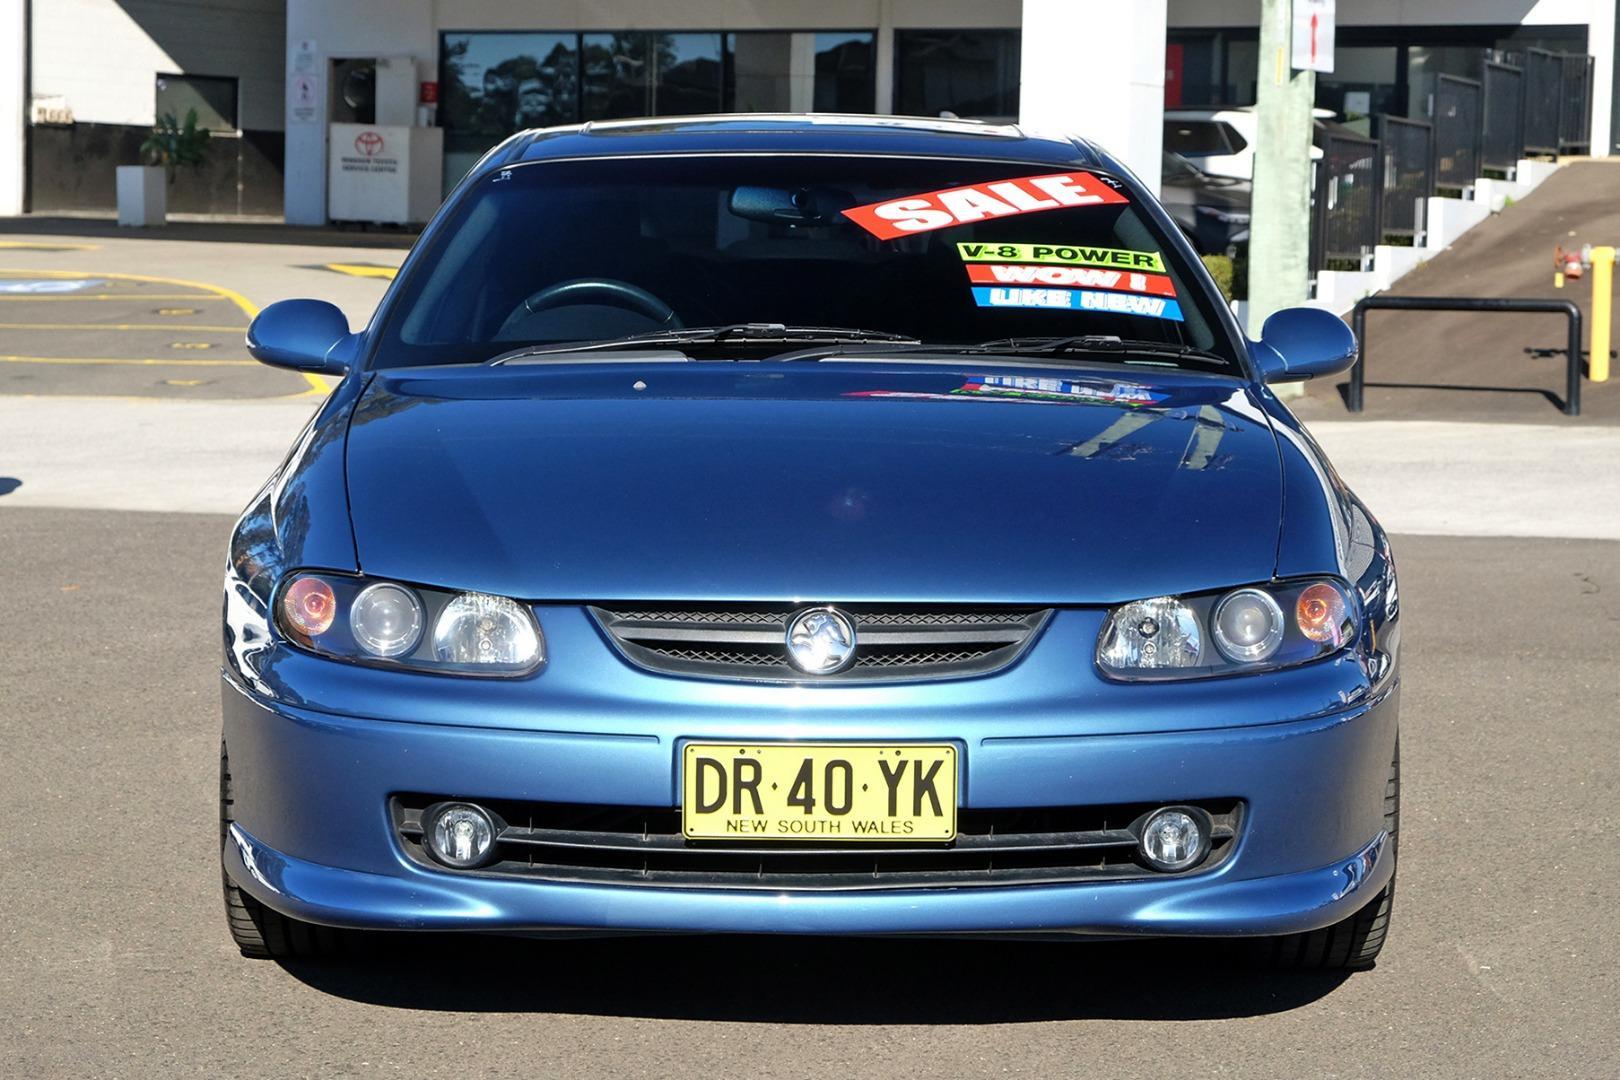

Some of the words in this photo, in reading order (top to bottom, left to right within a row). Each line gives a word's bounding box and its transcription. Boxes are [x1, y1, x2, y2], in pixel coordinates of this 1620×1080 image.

[874, 175, 1104, 231] SALE
[961, 244, 1018, 259] V-8
[1033, 247, 1154, 267] POWER
[989, 265, 1121, 288] WOW
[990, 288, 1072, 307] LIKE
[1080, 291, 1166, 316] NEW
[727, 820, 768, 833] NEW
[778, 820, 841, 834] SOUTH
[852, 821, 914, 834] WALES
